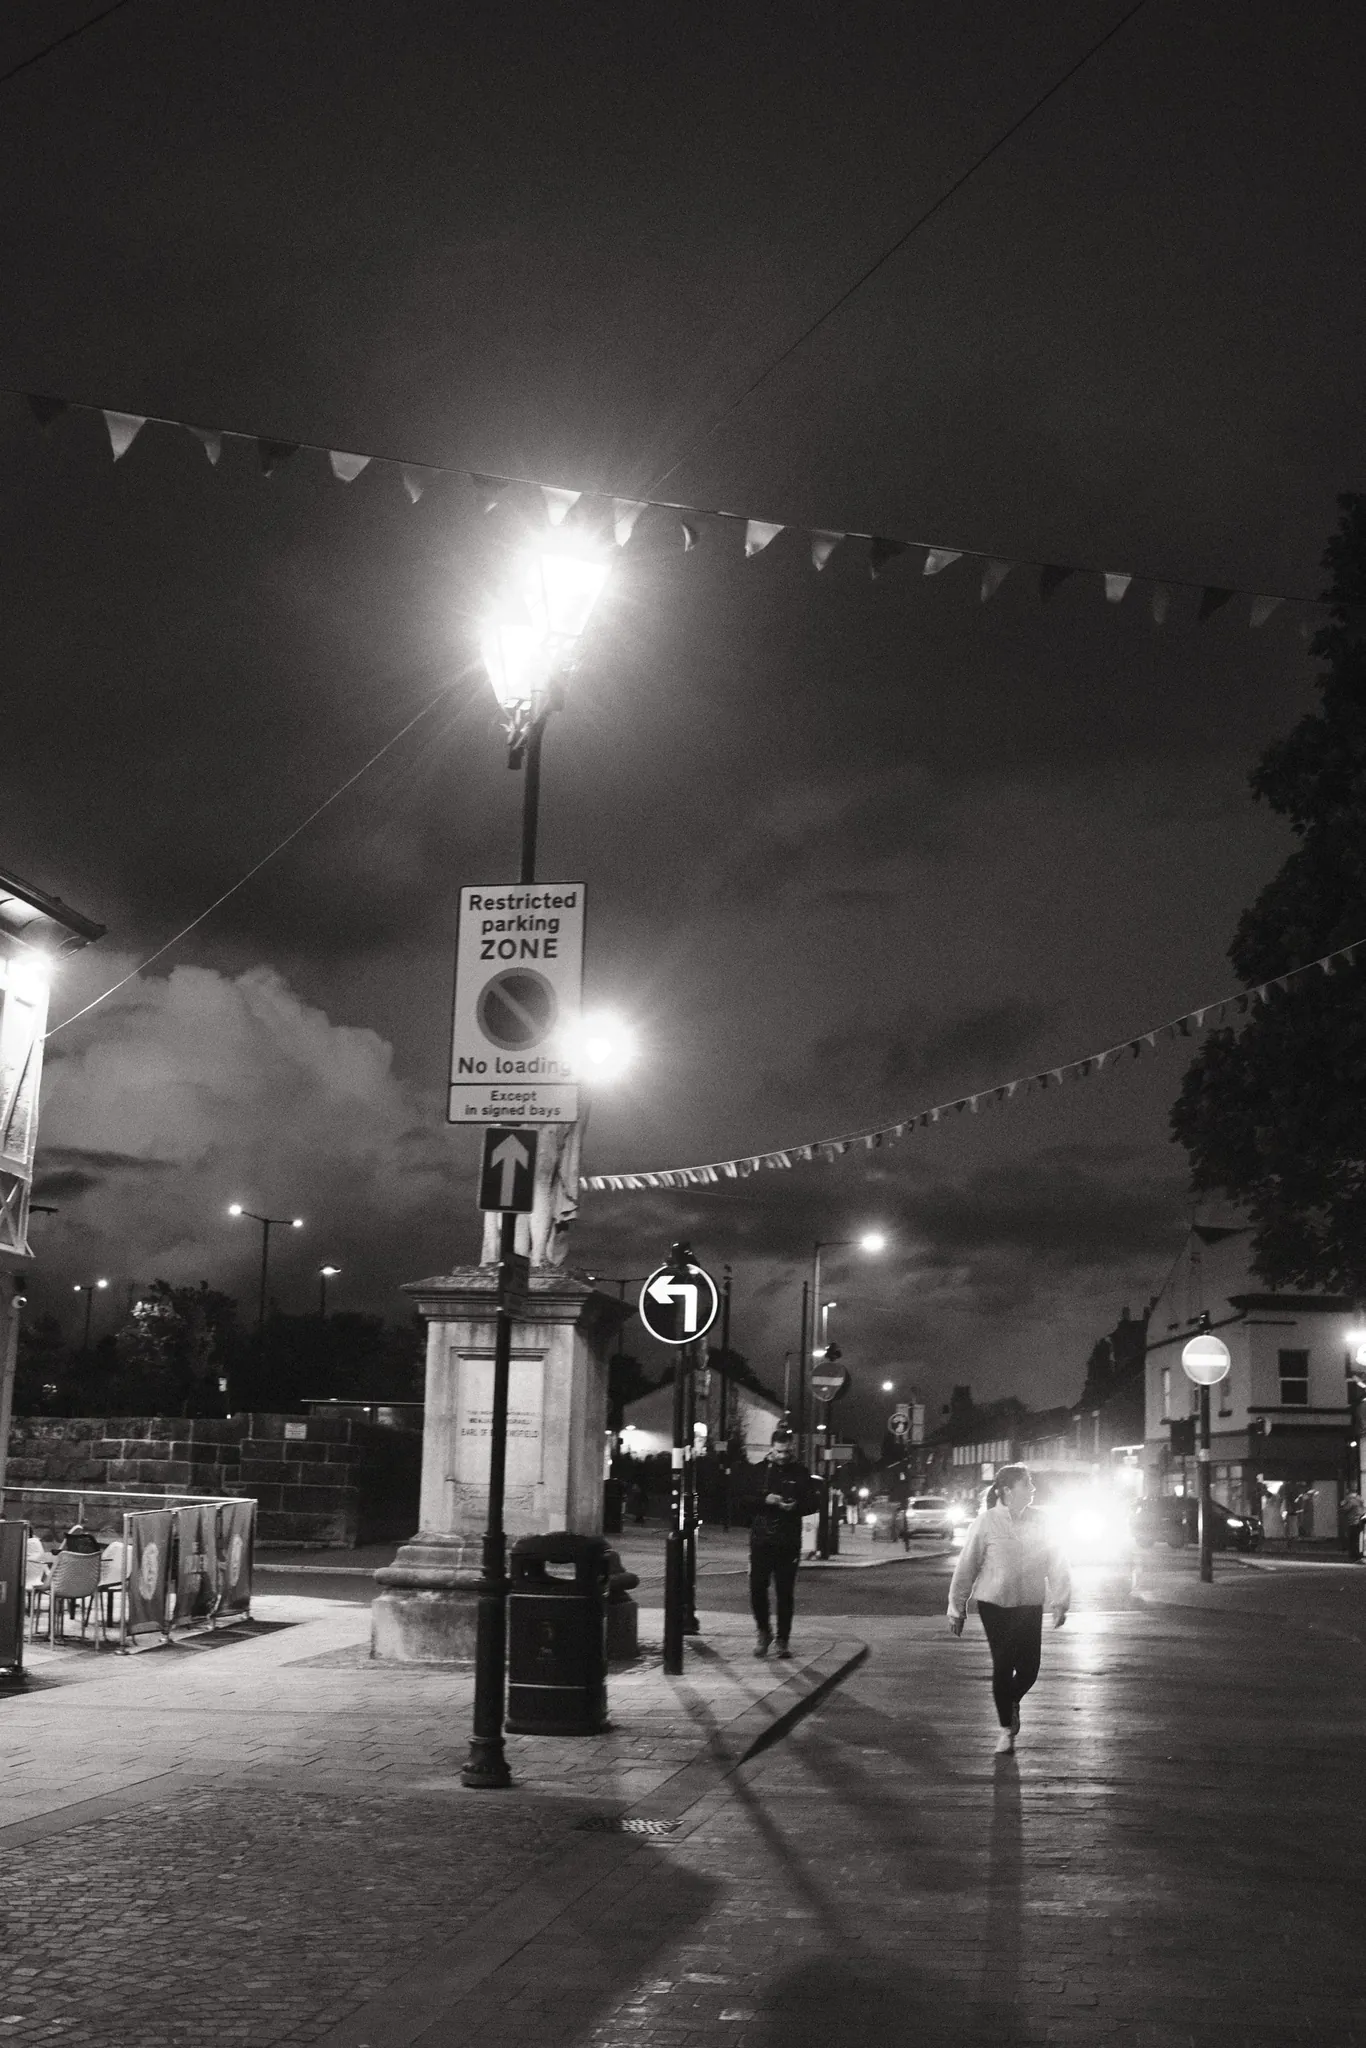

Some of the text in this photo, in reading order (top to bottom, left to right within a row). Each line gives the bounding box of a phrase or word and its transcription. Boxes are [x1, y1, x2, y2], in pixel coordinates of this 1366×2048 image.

[469, 892, 577, 911] Restricted
[482, 915, 560, 935] parking
[480, 938, 558, 960] ZONE
[458, 1057, 572, 1076] No loading
[490, 1090, 537, 1102] Except
[465, 1105, 561, 1117] in signed bays
